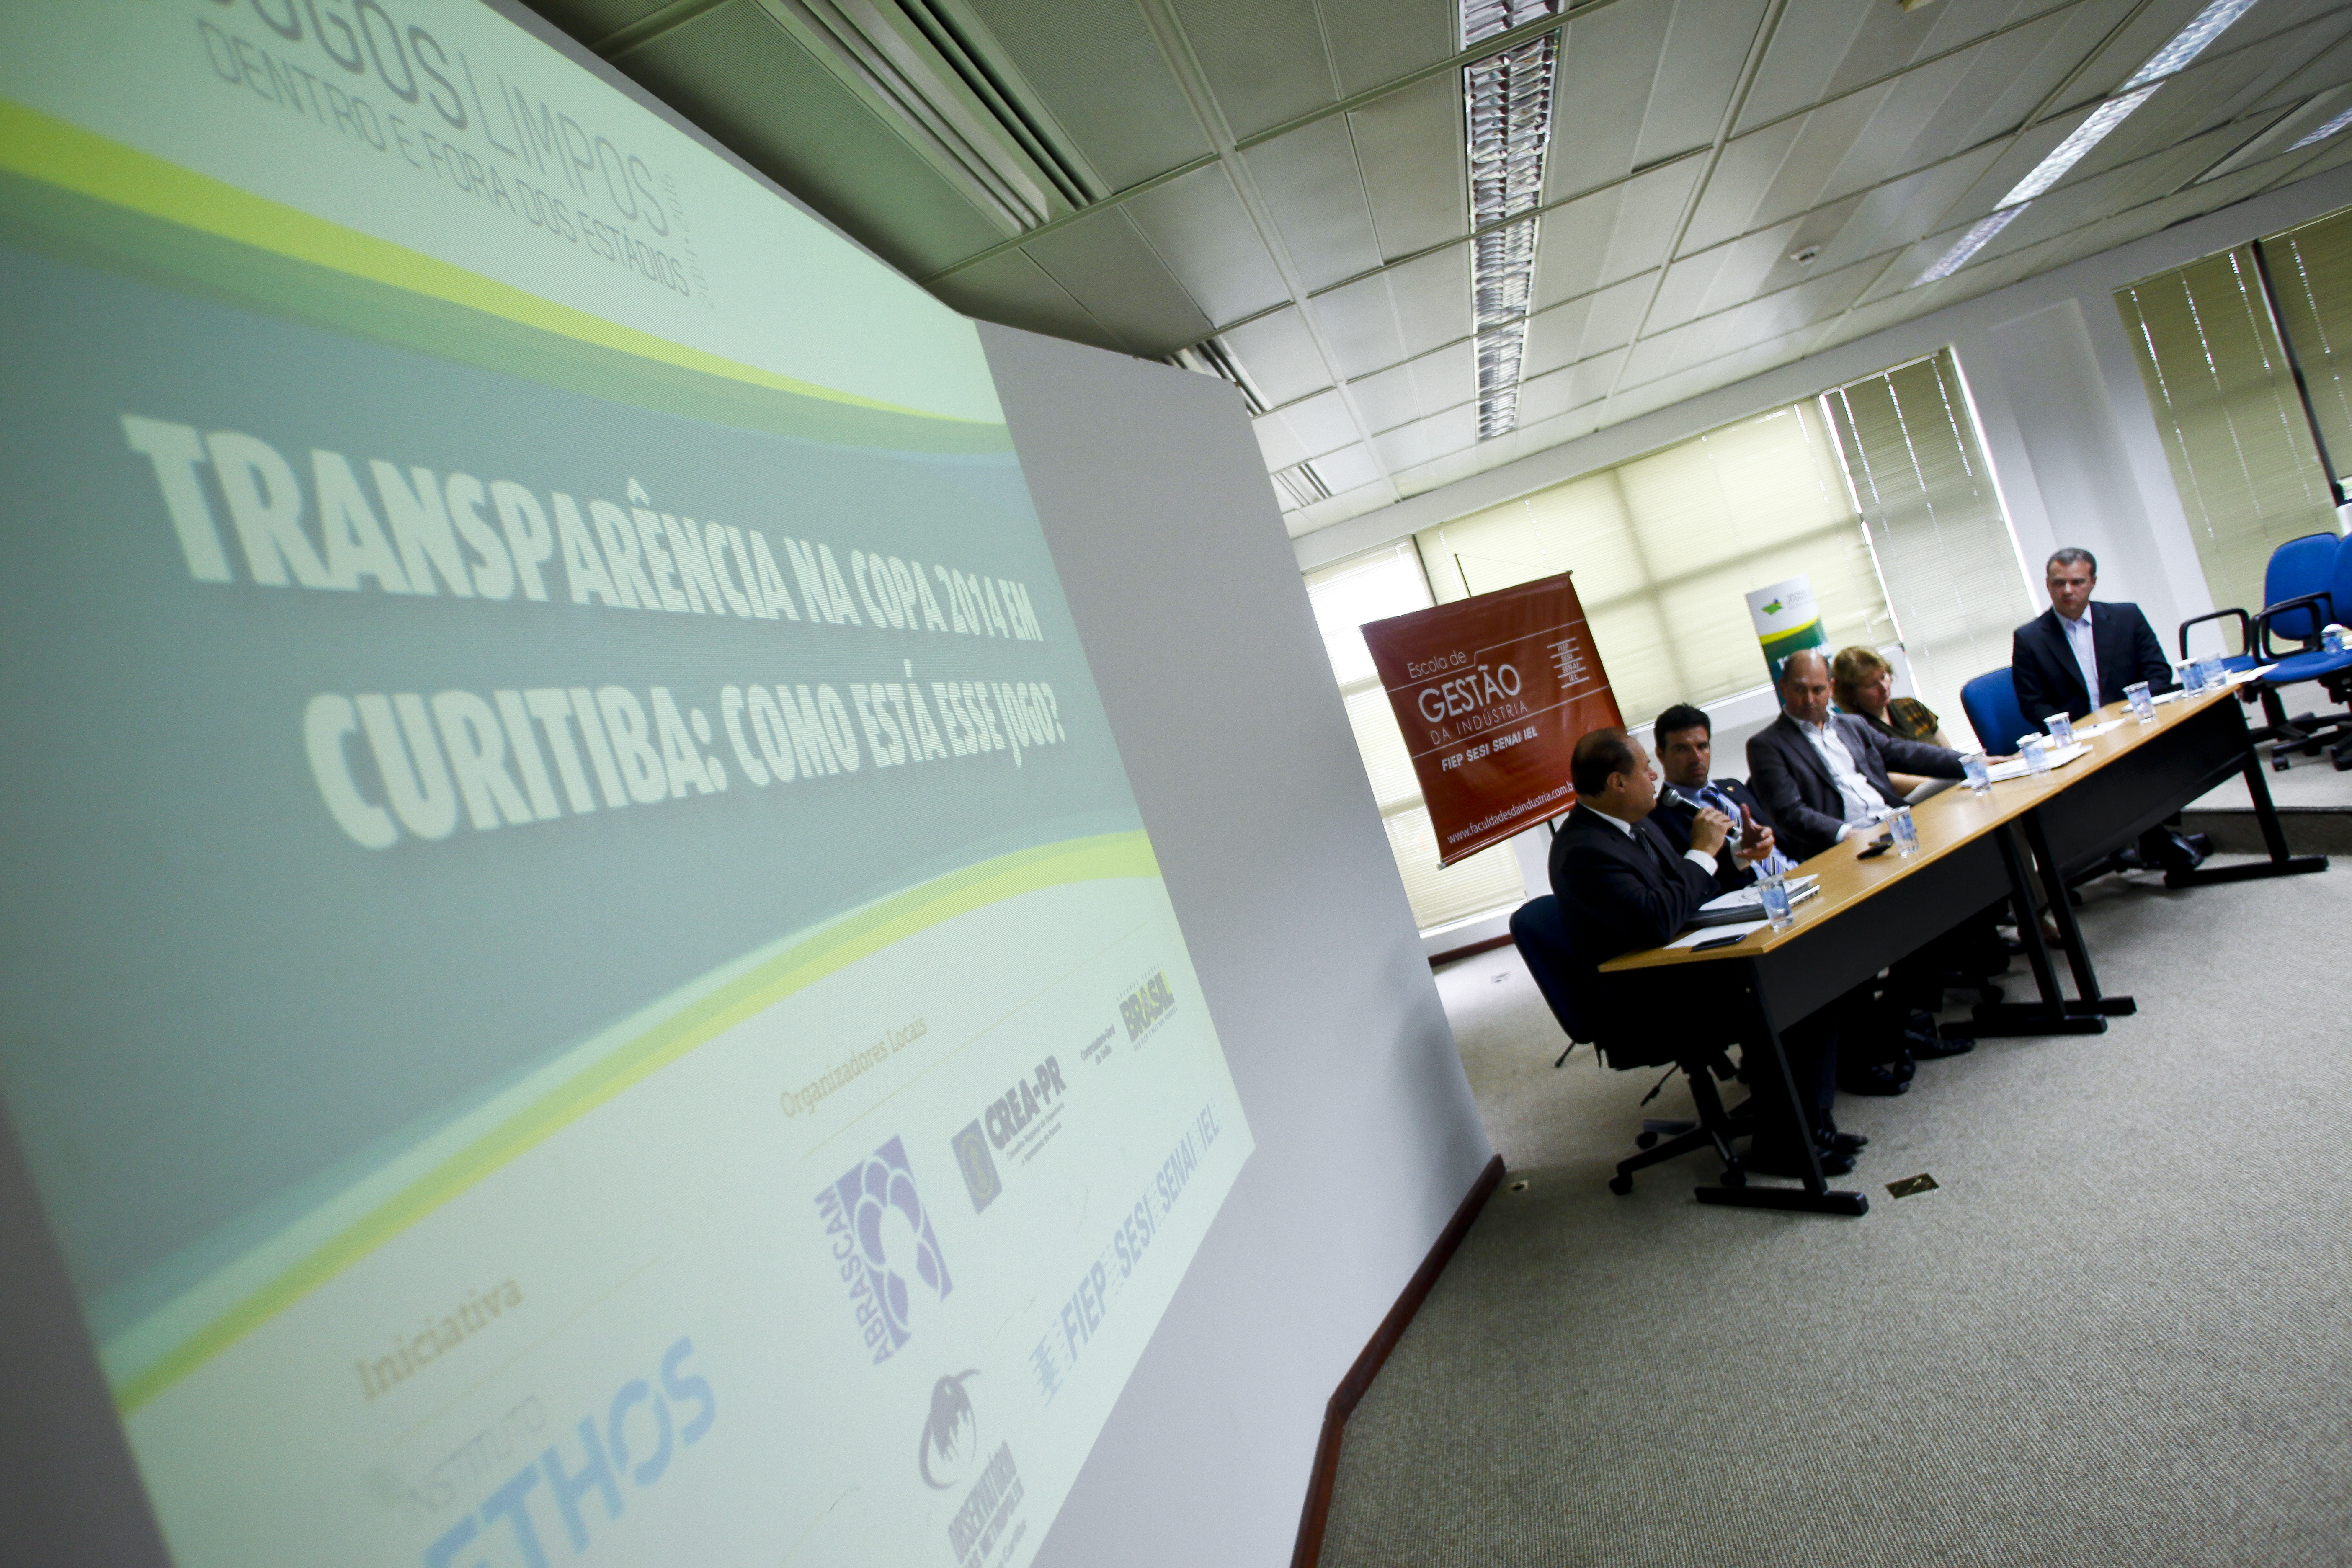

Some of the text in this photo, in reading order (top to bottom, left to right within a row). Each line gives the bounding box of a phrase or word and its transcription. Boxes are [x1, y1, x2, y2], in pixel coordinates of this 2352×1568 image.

[196, 17, 690, 297] DENTRO E FORA DOS ESTÁDIOS
[119, 412, 1044, 642] TRANSPARÊNCIA NA COPA 2014 EM
[1407, 650, 1467, 679] Escola de
[1418, 664, 1522, 723] GESTÃO
[303, 683, 728, 850] CURITIBA:
[720, 684, 859, 787] COMO
[849, 658, 948, 769] ESTÁ
[931, 681, 1007, 757] ESSE
[1430, 700, 1528, 745] DA INDÚSTRIA
[1441, 725, 1538, 772] FIEP SESI SENAI IEL
[1447, 780, 1574, 844] www.faculdadesdaindustria.com.b
[780, 1014, 929, 1119] Organizadores Locais
[985, 1054, 1067, 1151] CREA-PR
[814, 1184, 895, 1365] ABRASCAM
[1060, 1103, 1220, 1364] FIEP SESI SENAI IEL
[355, 1277, 527, 1404] Iniciativa
